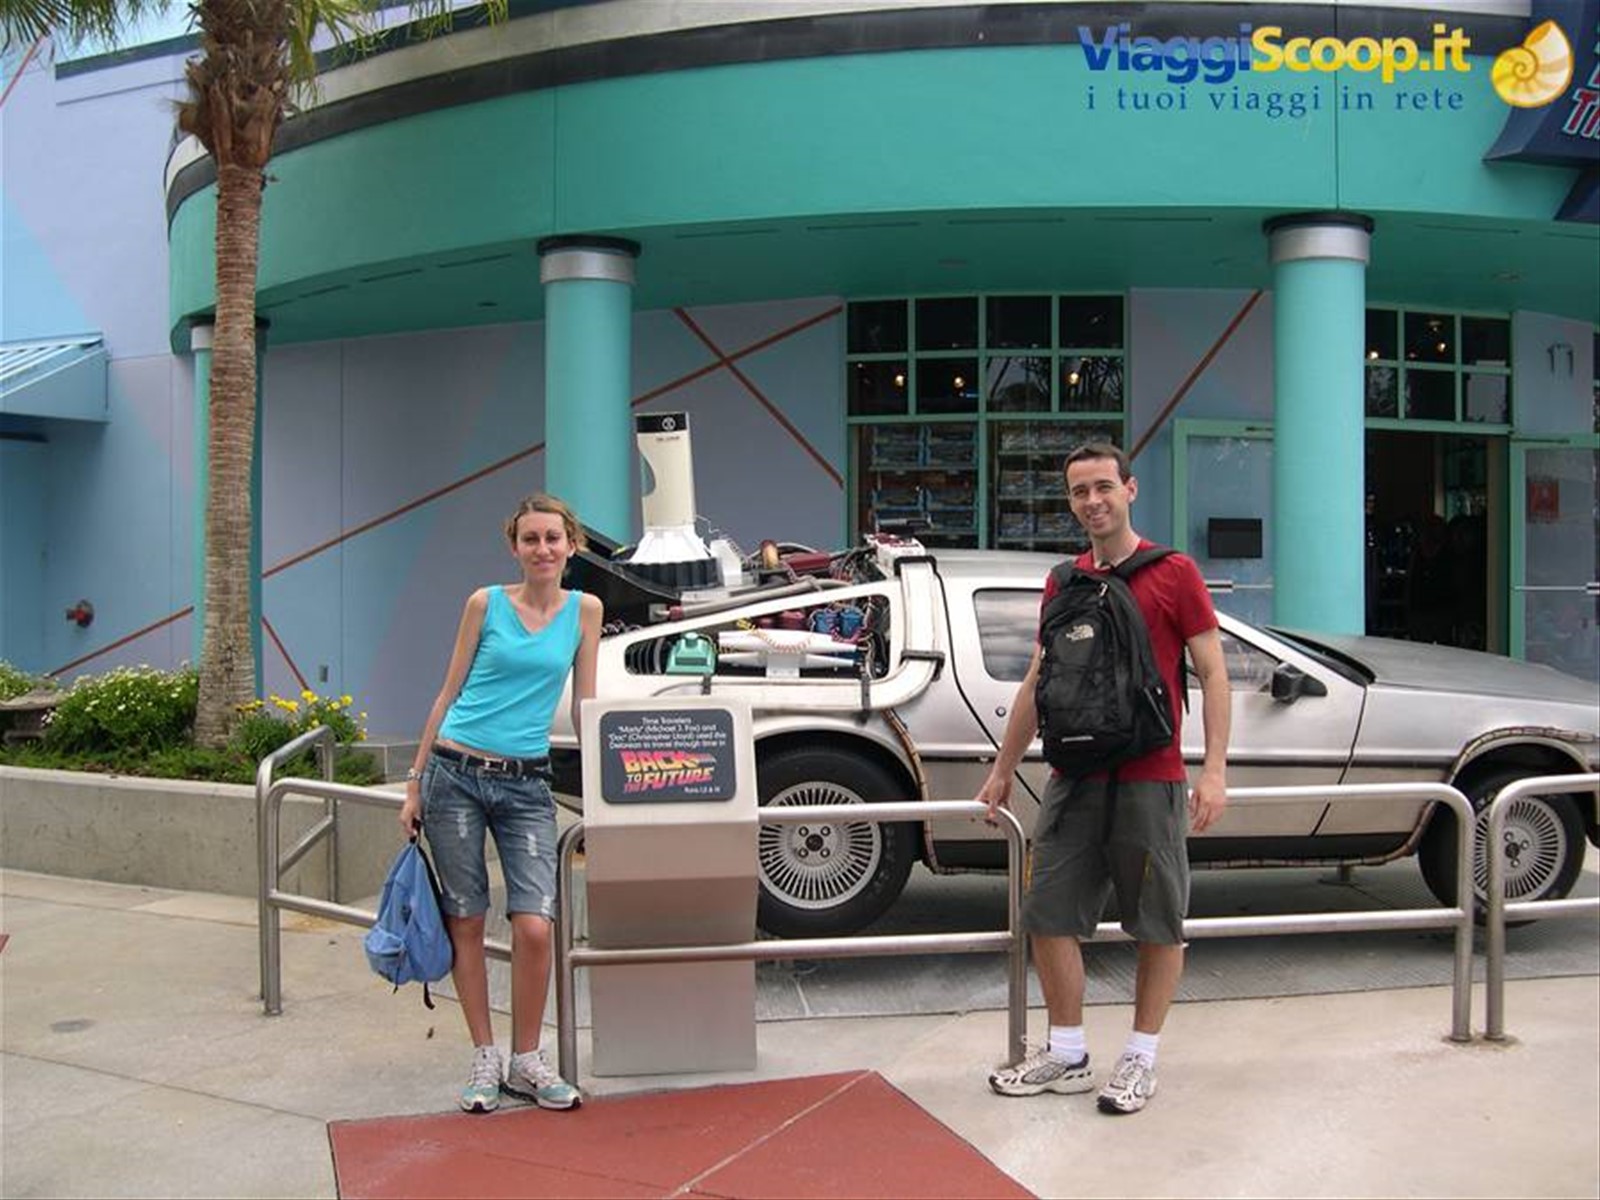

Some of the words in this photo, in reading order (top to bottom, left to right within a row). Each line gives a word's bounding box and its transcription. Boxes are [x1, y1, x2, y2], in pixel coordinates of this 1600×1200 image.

[620, 750, 716, 773] BACK
[626, 774, 642, 783] TO
[641, 767, 714, 792] FUTURE
